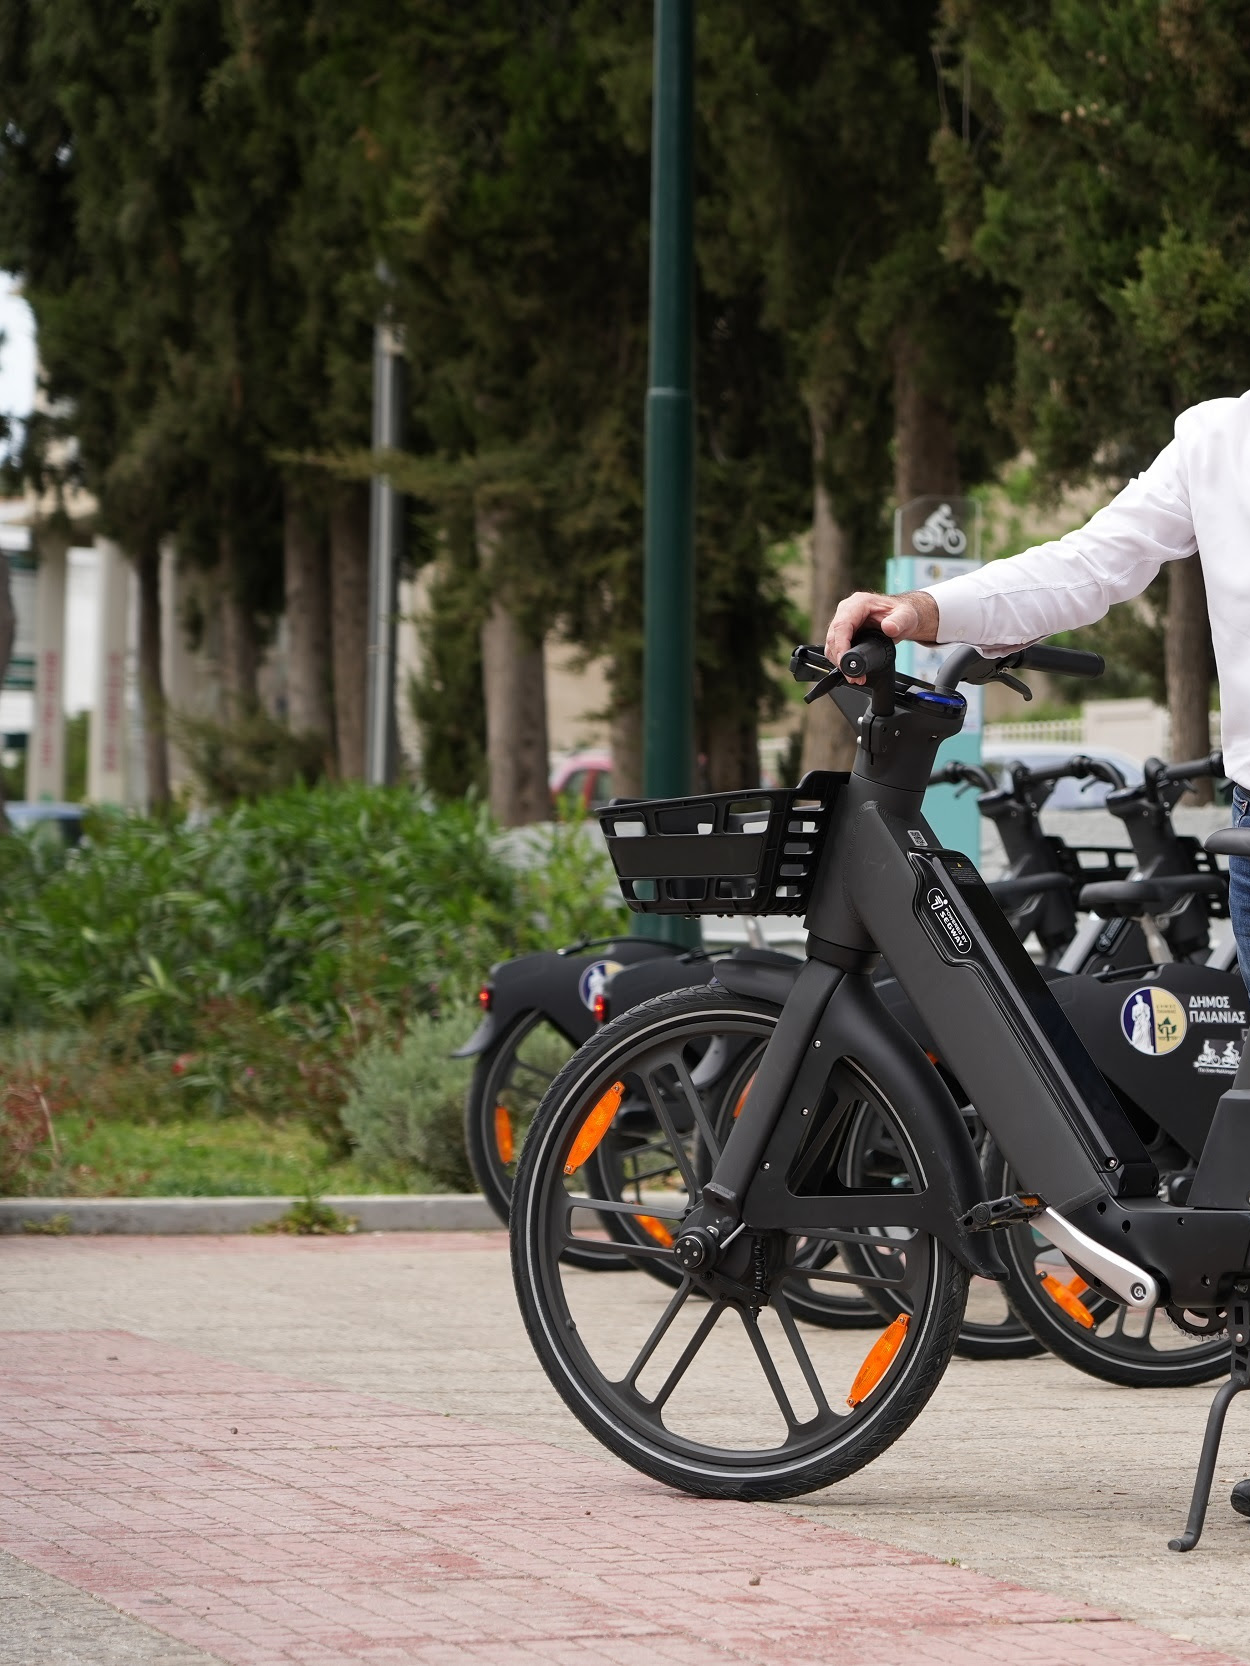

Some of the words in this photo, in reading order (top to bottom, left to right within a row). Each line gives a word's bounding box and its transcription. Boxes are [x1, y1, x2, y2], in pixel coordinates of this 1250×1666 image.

[940, 911, 964, 946] SEGWAY
[945, 908, 962, 935] POWERED
[1189, 996, 1230, 1008] ΔΗΜΟΣ
[1189, 1011, 1246, 1023] ΠΑΙΑΝΙΑΣ
